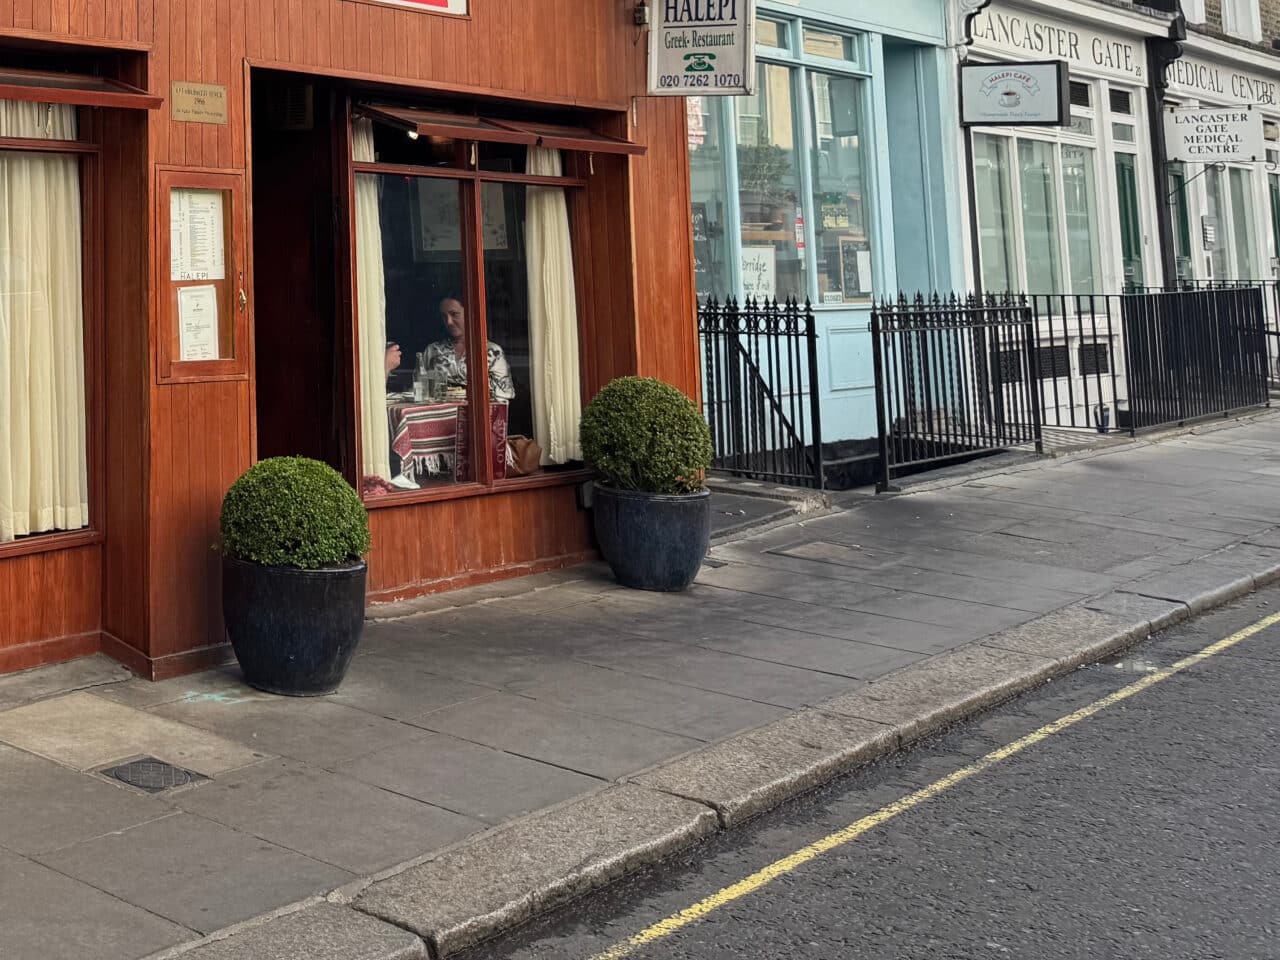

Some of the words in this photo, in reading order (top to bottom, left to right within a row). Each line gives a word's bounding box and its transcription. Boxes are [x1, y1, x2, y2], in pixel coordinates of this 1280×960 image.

[692, 29, 735, 48] Restaurant
[973, 12, 1080, 60] LANCASTER
[1091, 37, 1134, 72] GATE
[660, 75, 680, 87] 020
[683, 74, 709, 87] 7262
[714, 73, 740, 86] 1070
[989, 72, 1012, 83] HALEPI
[1165, 60, 1224, 94] MEDICAL
[1231, 73, 1277, 106] CENTRE
[1175, 113, 1249, 124] LANCASTER
[1195, 124, 1228, 133] GATE
[1183, 134, 1243, 144] MEDICAL
[1188, 145, 1240, 154] CENTRE
